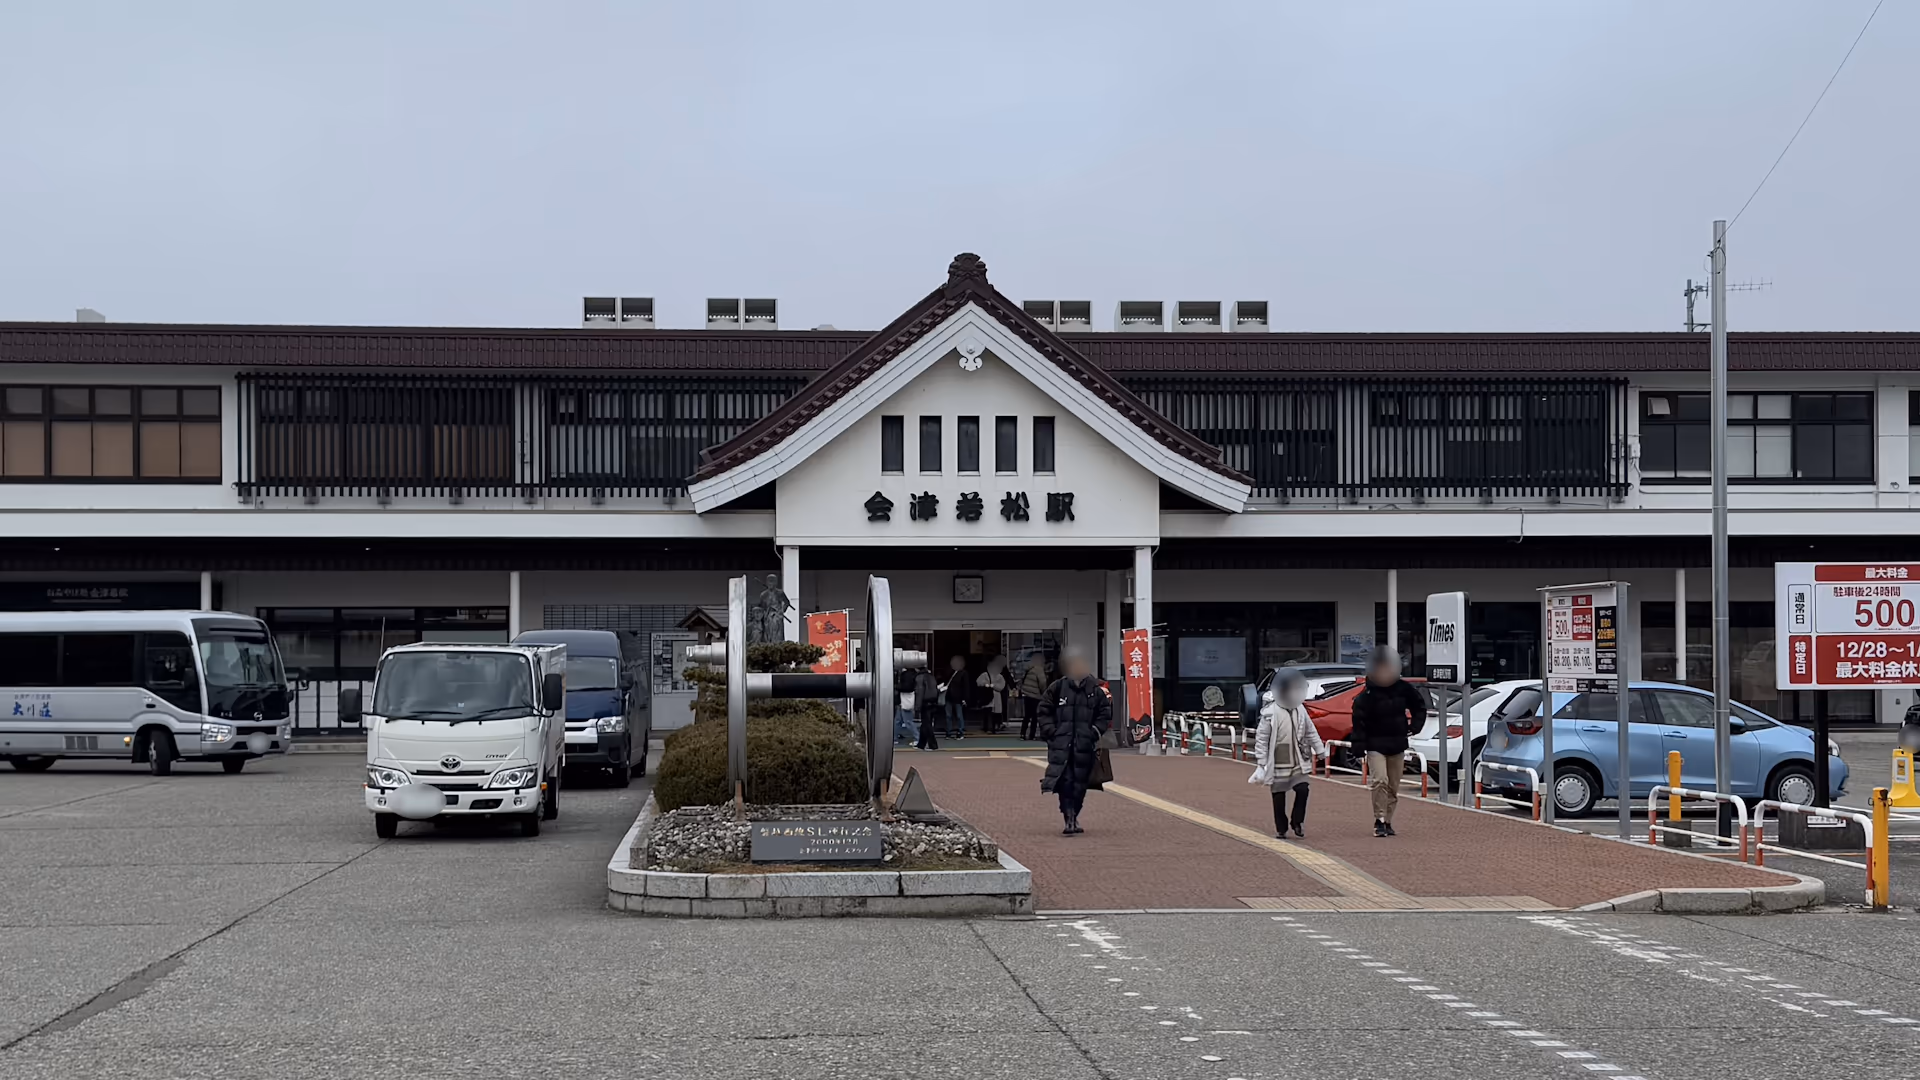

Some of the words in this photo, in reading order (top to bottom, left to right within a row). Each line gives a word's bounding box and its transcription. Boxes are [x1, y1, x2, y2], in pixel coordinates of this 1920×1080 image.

[864, 491, 1075, 521] 会津若松駅
[1865, 567, 1908, 578] 最大料金
[1833, 586, 1901, 597] 駐車後24時間
[1795, 592, 1805, 624] 通常日
[1429, 618, 1455, 642] Times
[1795, 641, 1806, 675] 特定日
[1836, 661, 1920, 678] 最大料金休
